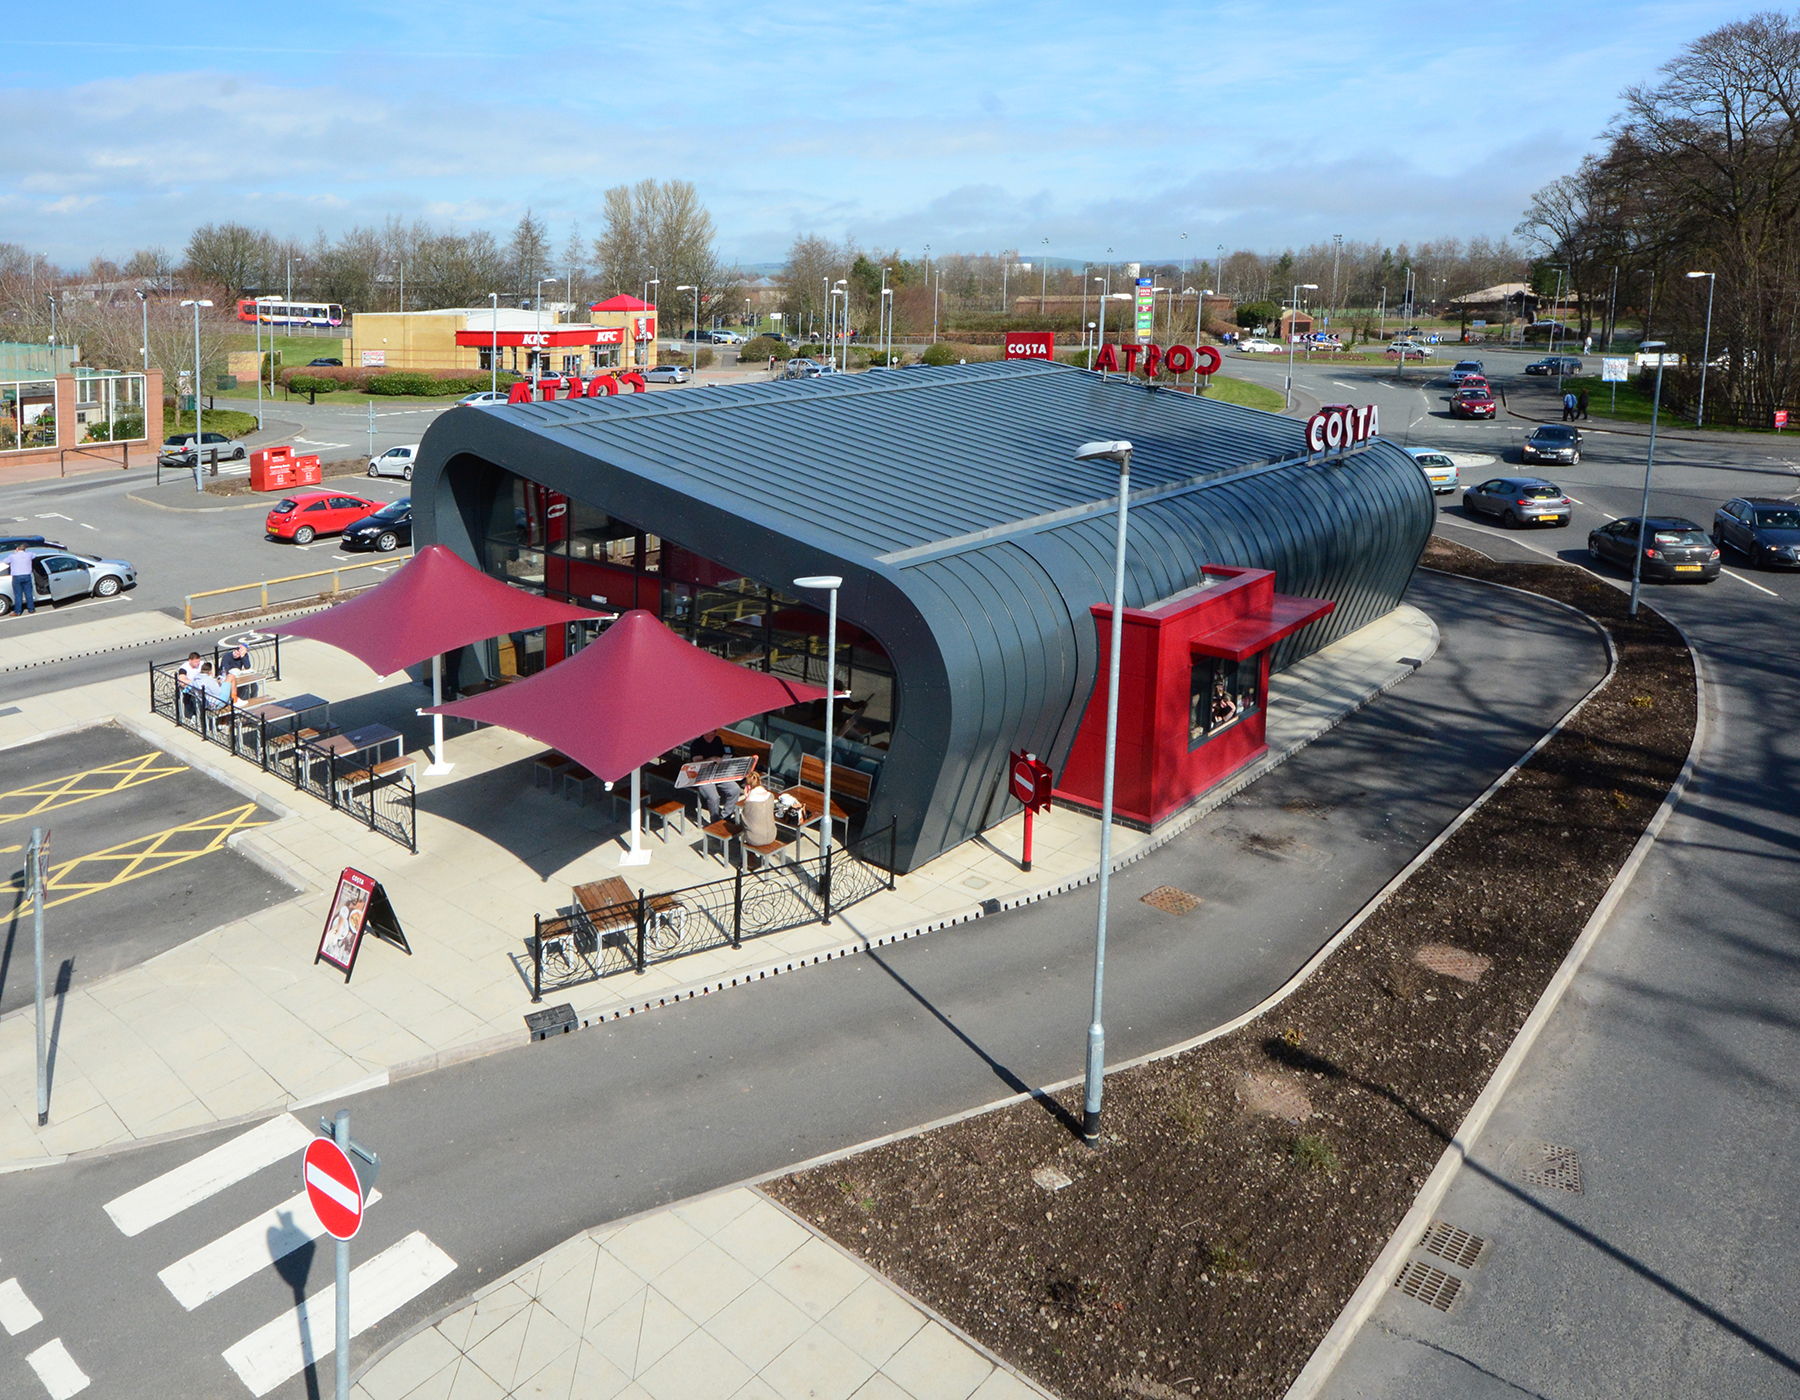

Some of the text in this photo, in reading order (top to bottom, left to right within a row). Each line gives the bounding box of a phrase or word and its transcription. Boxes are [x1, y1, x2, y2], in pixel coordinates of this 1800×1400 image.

[522, 333, 550, 345] KFC
[596, 331, 618, 342] KFC
[1008, 343, 1047, 355] COSTA
[1309, 405, 1379, 451] COSTA
